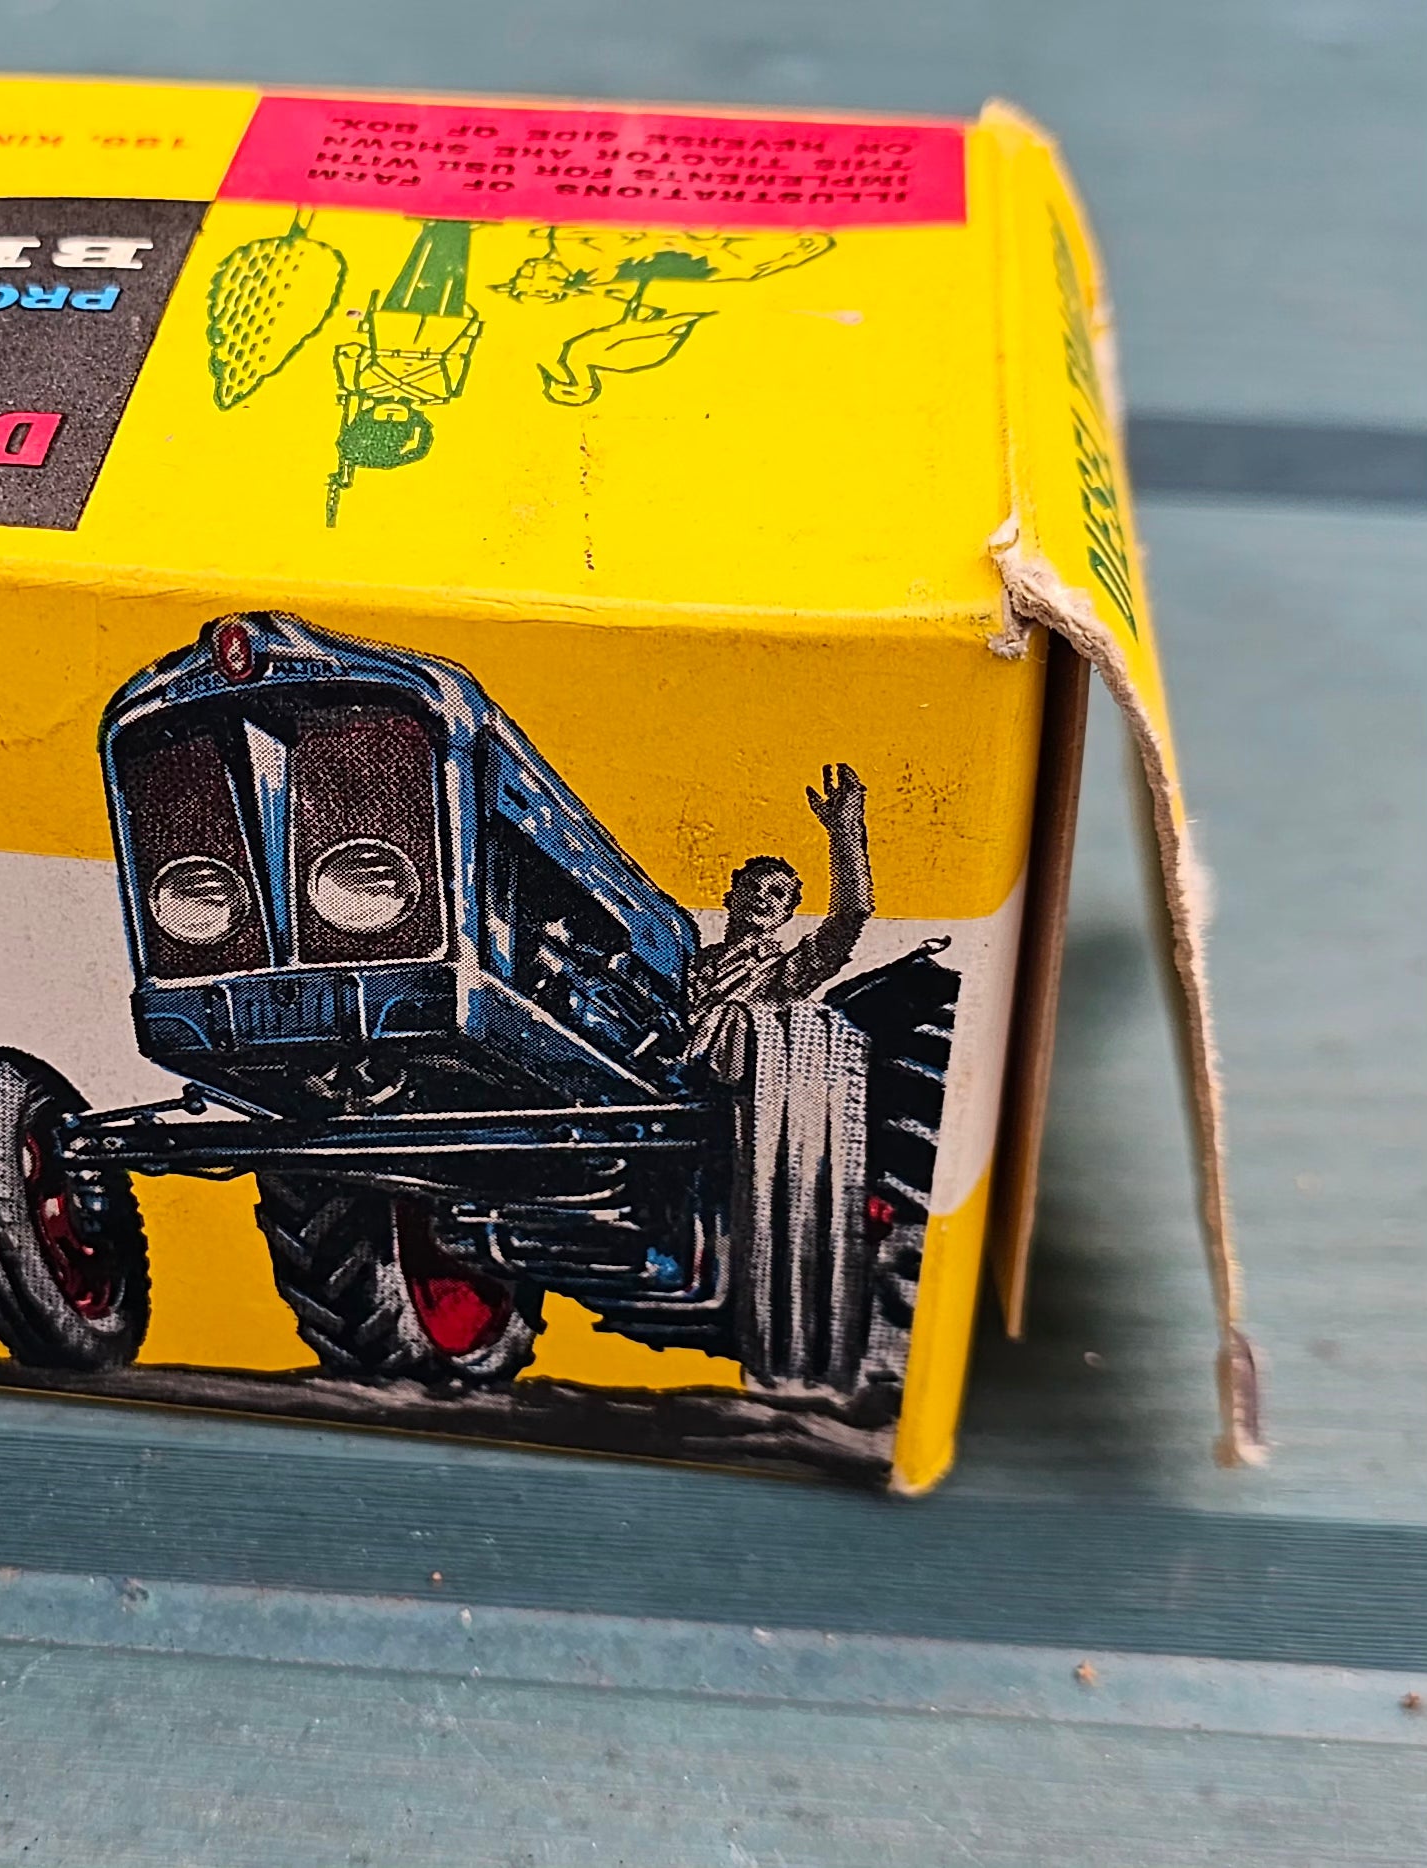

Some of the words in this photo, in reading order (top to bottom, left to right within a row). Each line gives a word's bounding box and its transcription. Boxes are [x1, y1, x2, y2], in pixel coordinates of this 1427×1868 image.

[322, 134, 470, 156] SHOWN
[315, 151, 420, 170] WITH
[598, 148, 783, 168] TRACTOR
[307, 168, 422, 188] FARM
[535, 164, 613, 181] FOR
[633, 167, 909, 187] IMPLEMENTS
[462, 179, 516, 194] OF
[554, 181, 909, 204] ILLUSTRATIONS
